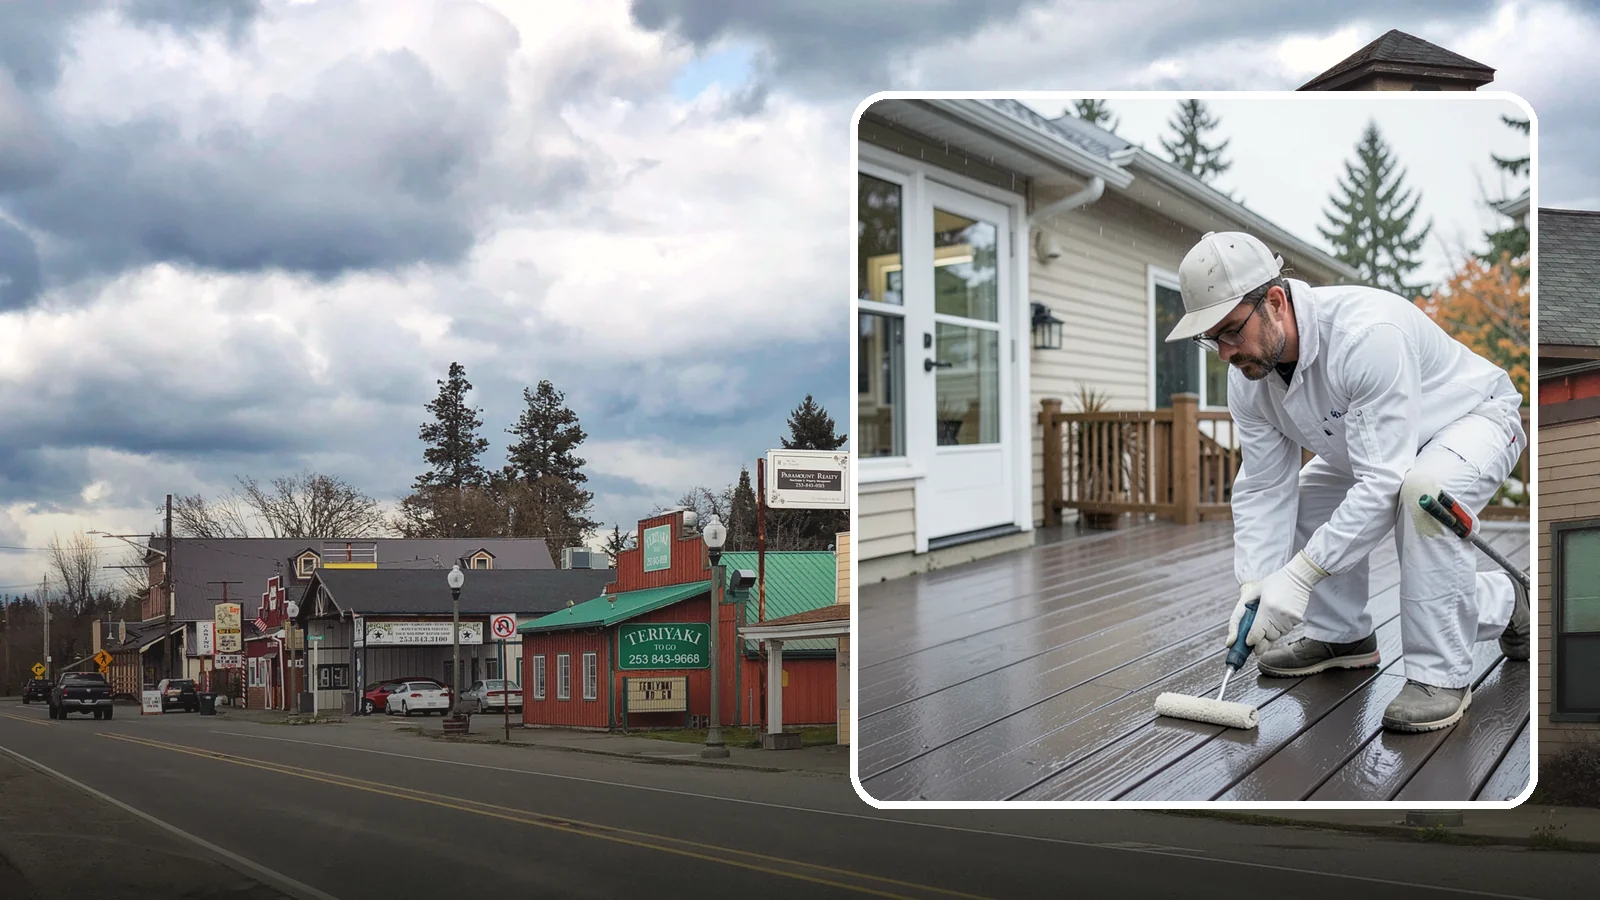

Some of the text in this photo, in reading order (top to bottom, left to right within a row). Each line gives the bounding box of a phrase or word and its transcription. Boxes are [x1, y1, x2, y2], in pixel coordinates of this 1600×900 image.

[781, 471, 839, 480] PARAMOUNT REALTY
[624, 628, 702, 646] TERIYAKI
[629, 654, 700, 664] 253 843-9668
[639, 681, 672, 691] TERIYAKI
